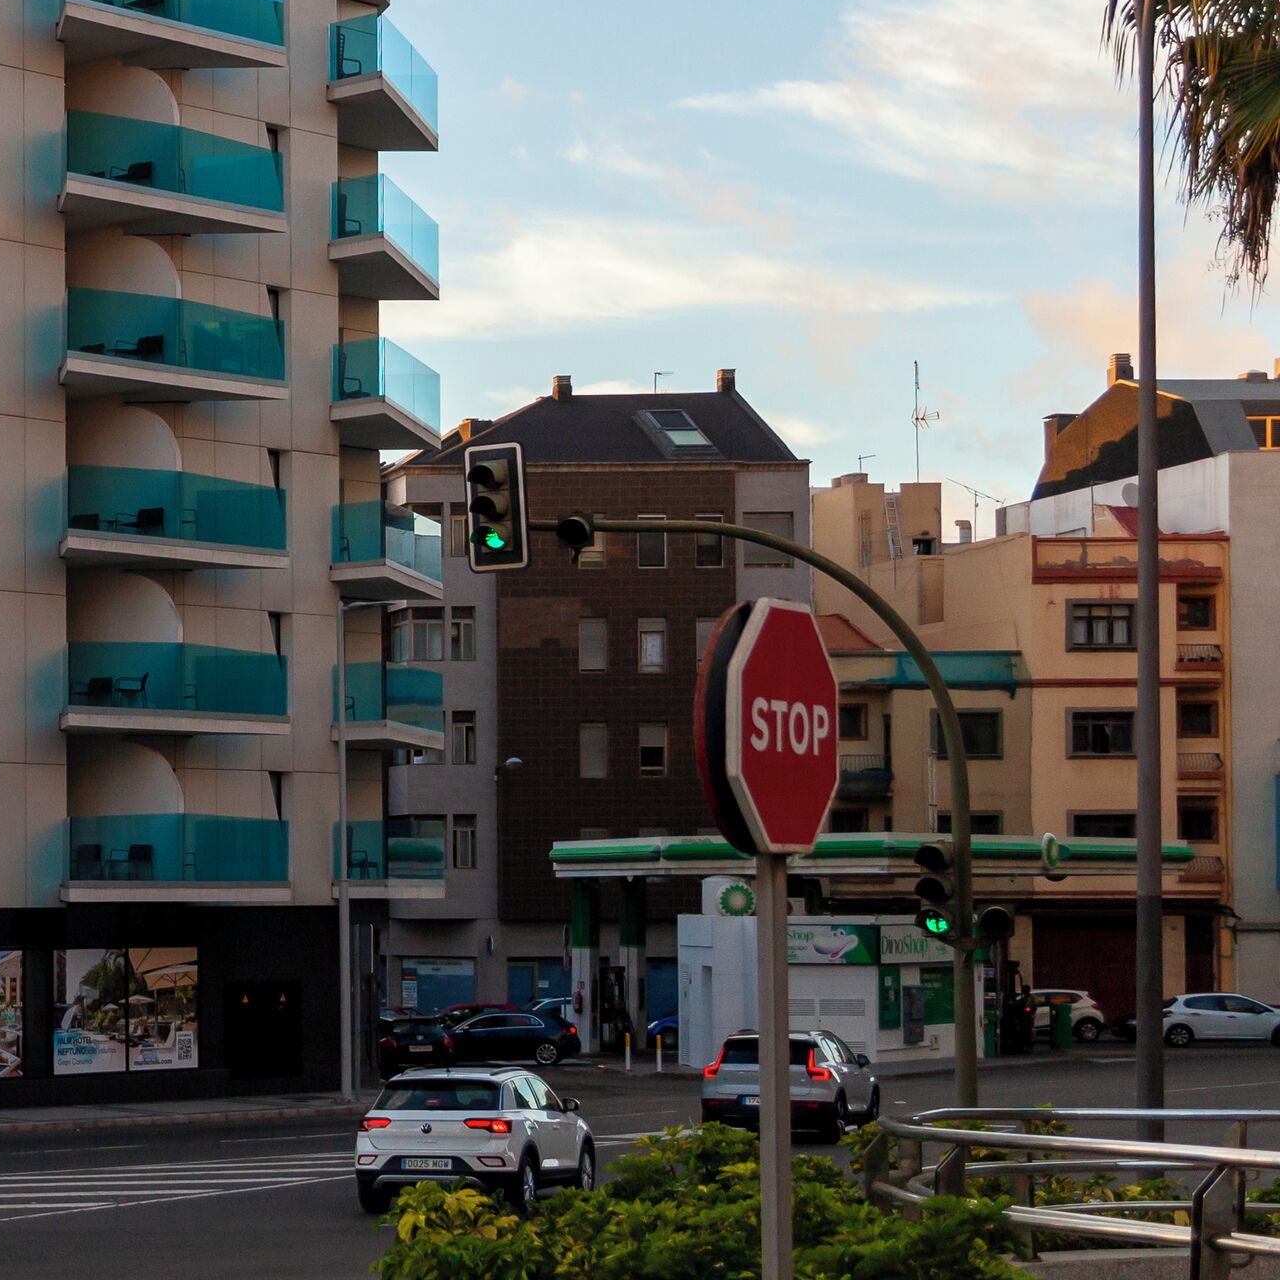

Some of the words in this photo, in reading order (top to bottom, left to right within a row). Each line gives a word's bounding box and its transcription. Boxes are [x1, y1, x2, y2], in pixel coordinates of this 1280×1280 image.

[750, 696, 829, 756] STOP
[881, 934, 929, 958] DinoShop
[407, 1159, 430, 1168] 0025
